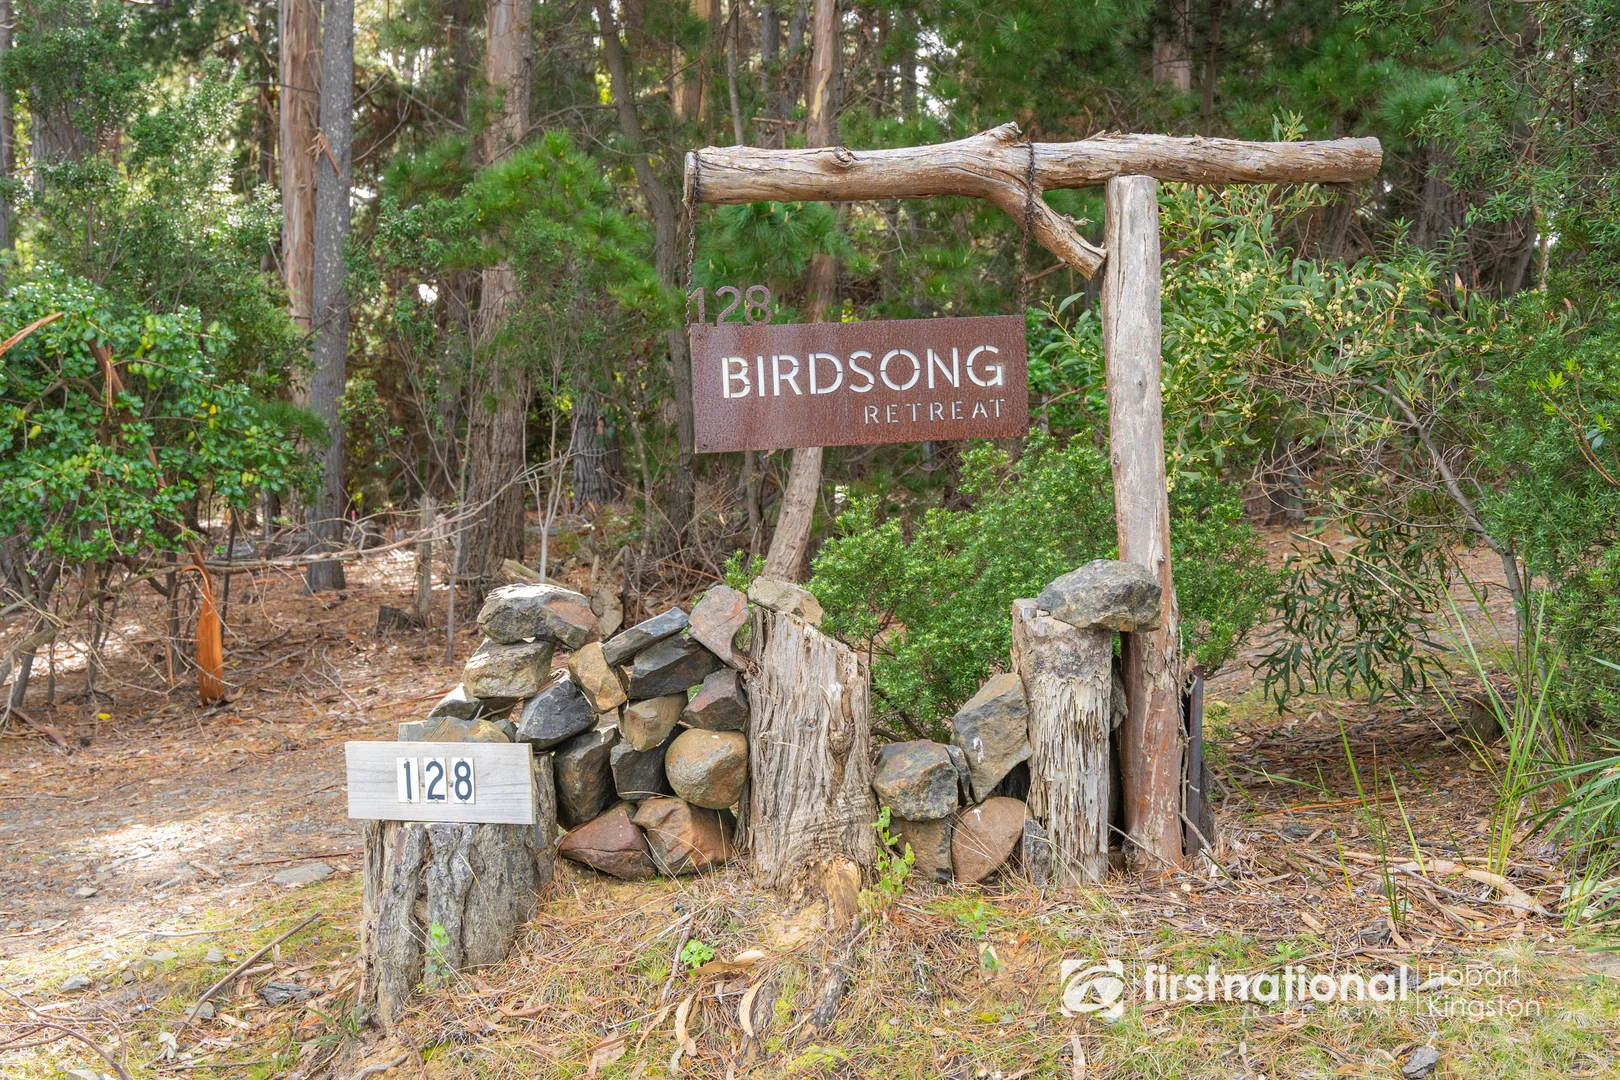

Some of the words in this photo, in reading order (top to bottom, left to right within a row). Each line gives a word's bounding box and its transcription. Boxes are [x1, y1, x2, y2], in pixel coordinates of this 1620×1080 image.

[690, 285, 773, 327] 128
[721, 345, 1003, 398] BIRDSONG
[865, 399, 1005, 424] RETREAT
[403, 760, 472, 801] 128
